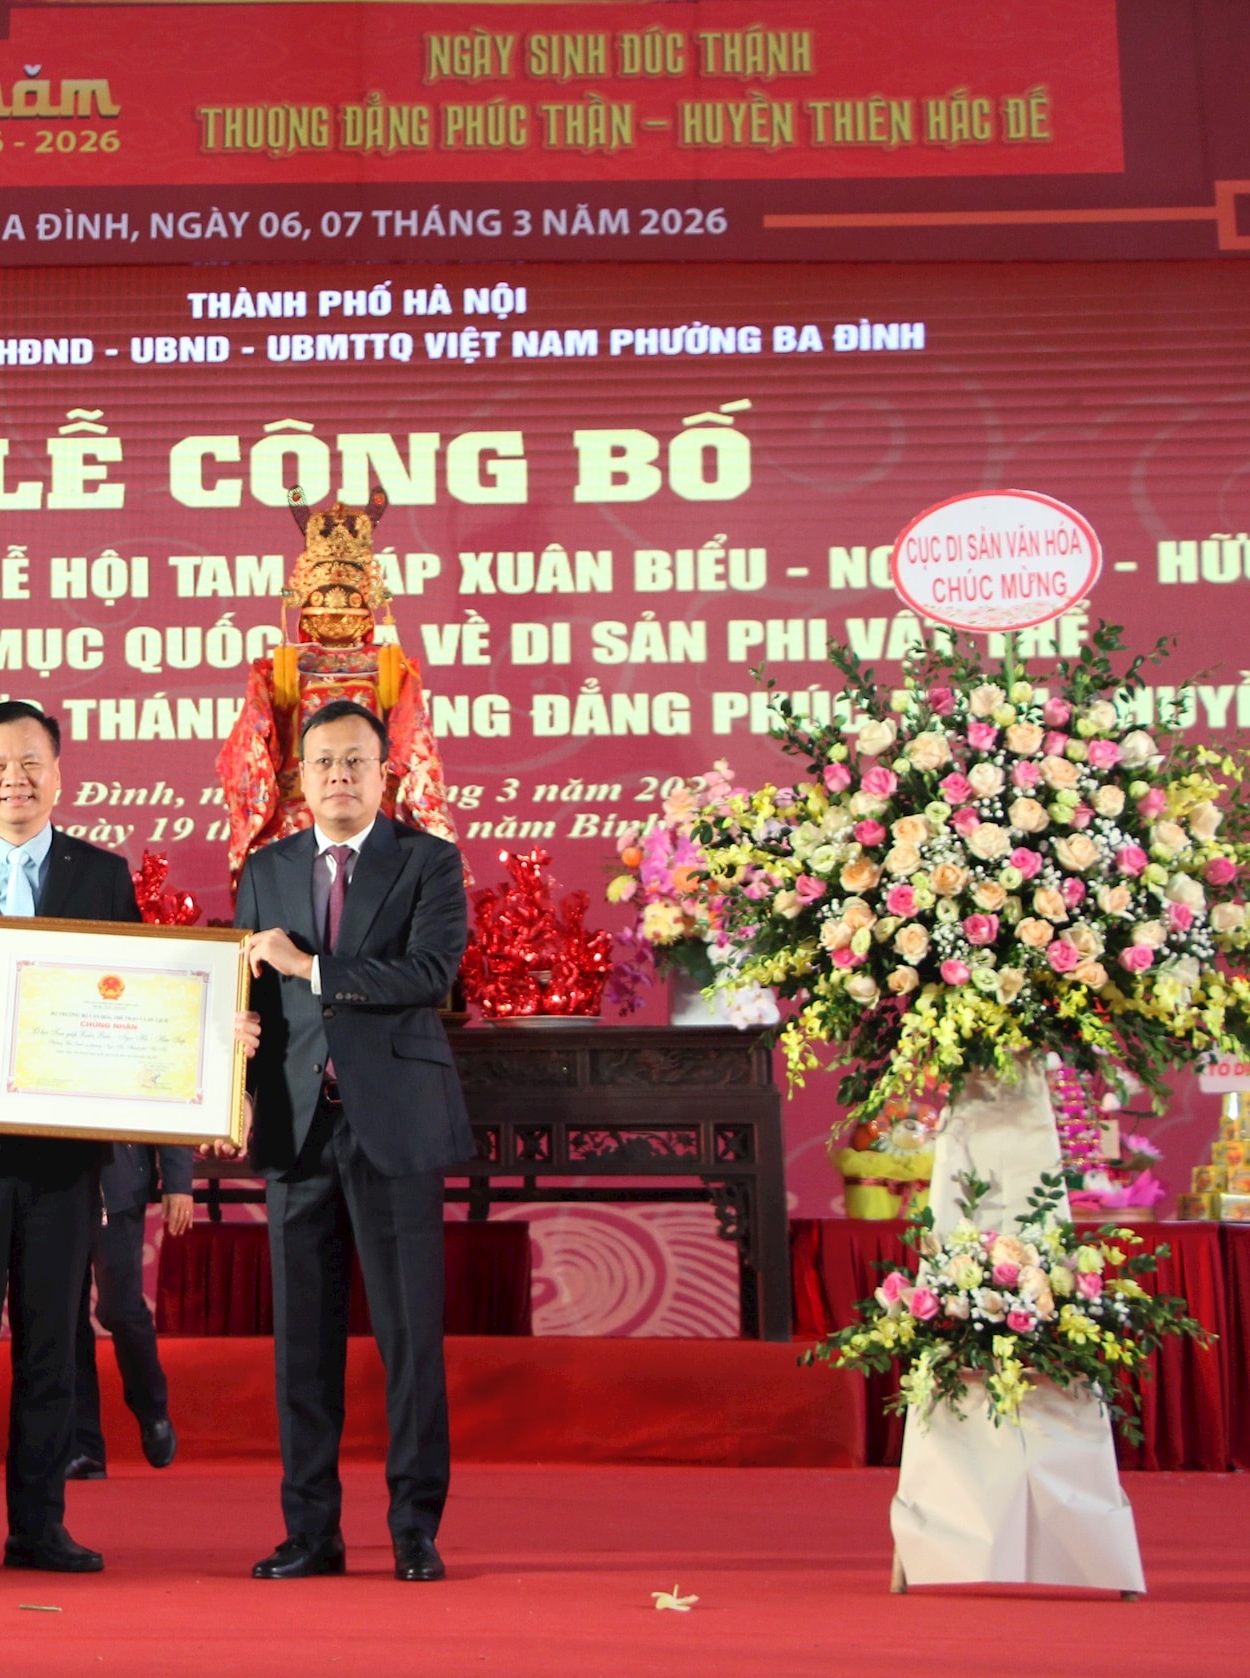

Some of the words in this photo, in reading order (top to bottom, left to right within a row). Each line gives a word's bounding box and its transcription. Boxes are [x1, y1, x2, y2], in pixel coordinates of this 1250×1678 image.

[429, 28, 514, 79] NGÀY
[530, 33, 607, 79] SINH
[699, 25, 812, 78] THÁNH
[34, 129, 121, 153] 2026
[343, 91, 430, 152] ĐẲNG
[446, 96, 528, 147] PHÚC
[542, 91, 633, 150] THẦN
[683, 91, 794, 147] HUYỀN
[808, 95, 912, 147] THIÊN
[1004, 85, 1050, 140] ĐẾ
[36, 207, 140, 243] ĐÌNH,
[150, 206, 250, 240] NGÀY
[258, 211, 312, 242] 06,
[321, 210, 364, 238] 07
[372, 204, 503, 238] THÁNG
[513, 209, 533, 237] 3
[543, 203, 631, 236] NĂM
[639, 207, 729, 236] 2026
[187, 286, 308, 319] THÀNH
[318, 280, 392, 317] PHỐ
[403, 283, 453, 316] HÀ
[463, 281, 528, 320] NỘI
[131, 335, 230, 364] UBND
[267, 332, 414, 363] UBMTTQ
[424, 326, 501, 364] VIỆT
[511, 329, 599, 357] NAM
[610, 320, 762, 356] PHƯỜNG
[772, 325, 823, 353] BA
[833, 318, 925, 352] ĐÌNH
[168, 418, 529, 508] CÔNG
[573, 398, 752, 504] BỐ
[49, 548, 149, 607] HỘI
[168, 555, 285, 598] TAM
[373, 546, 441, 595] ÁP
[458, 543, 613, 595] XUÂN
[633, 533, 767, 592] BIỂU
[1157, 532, 1250, 585] HỮ
[906, 535, 942, 571] CỤC
[946, 533, 963, 562] DI
[1006, 525, 1040, 557] VĂN
[1045, 520, 1083, 555] HÓA
[932, 568, 994, 604] CHÚC
[1001, 564, 1068, 600] MỪNG
[124, 611, 283, 673] QUỐC
[420, 608, 492, 665] VỀ
[511, 622, 571, 665] DI
[591, 610, 707, 664] SẢN
[727, 618, 828, 663] PHI
[529, 676, 692, 738] ĐẲNG
[72, 781, 185, 809] Đình,
[496, 778, 521, 802] 3
[532, 777, 623, 803] năm
[146, 817, 195, 842] 19
[466, 815, 556, 840] năm
